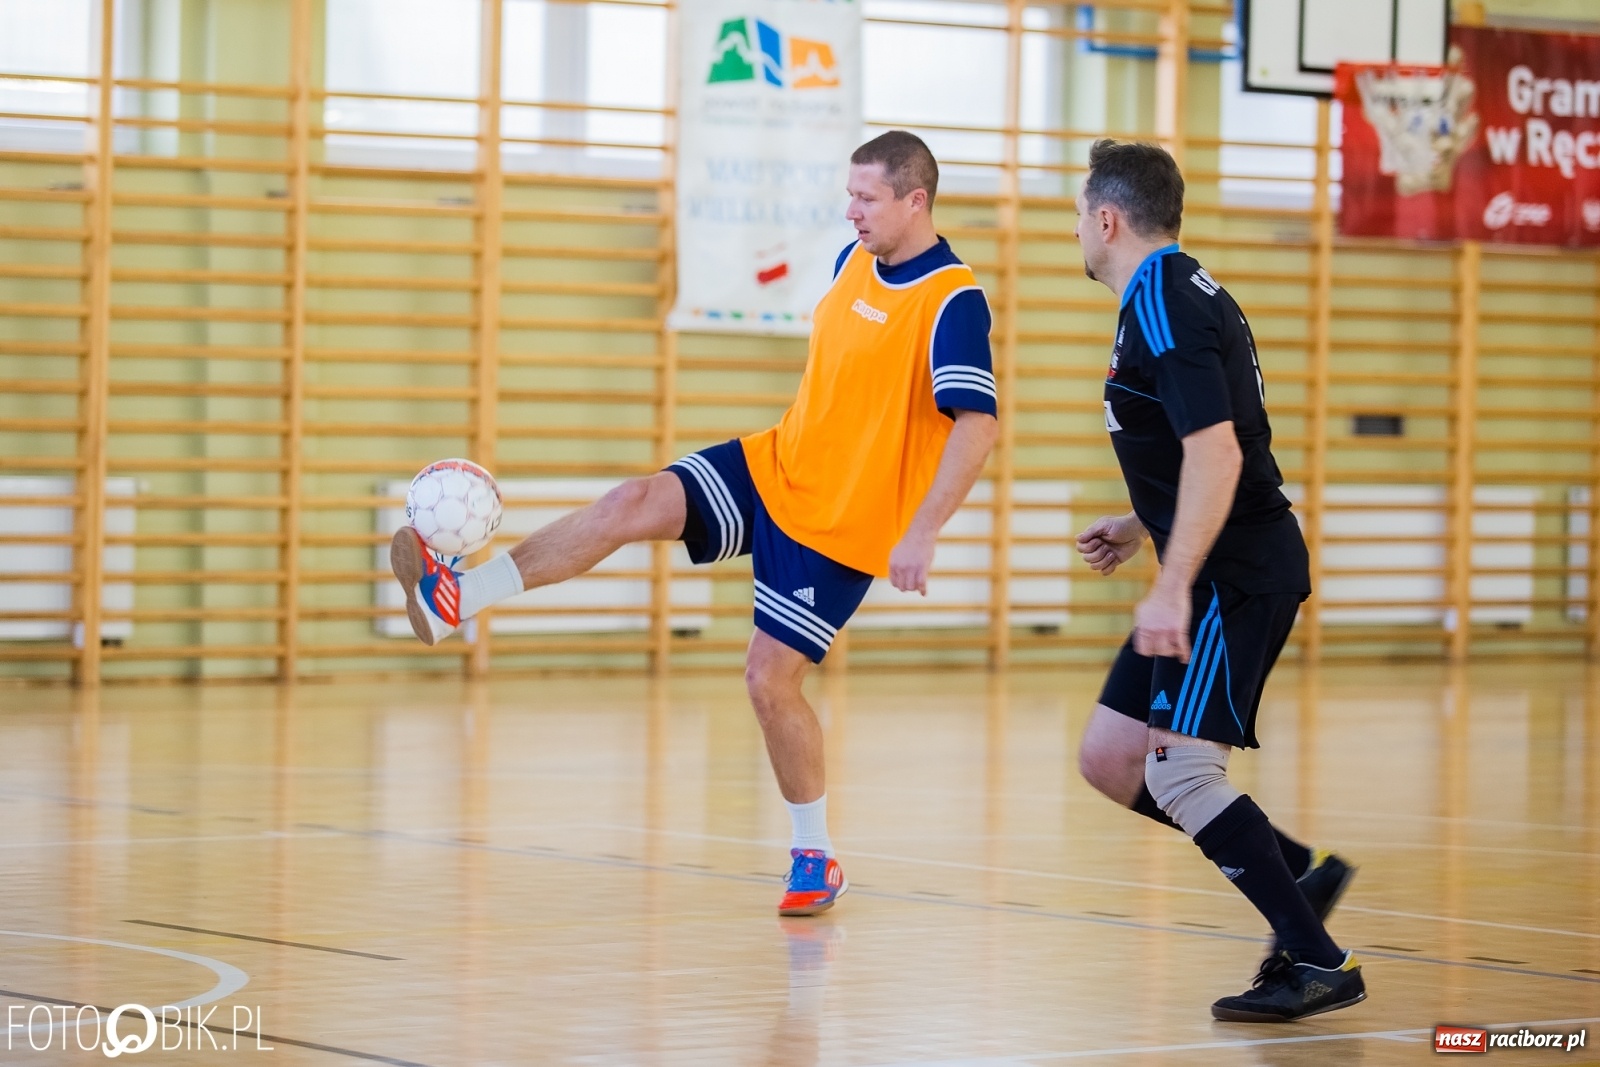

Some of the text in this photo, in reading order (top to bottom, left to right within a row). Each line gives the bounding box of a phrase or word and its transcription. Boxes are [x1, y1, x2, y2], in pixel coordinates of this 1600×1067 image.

[1485, 118, 1600, 179] w Ręc
[852, 298, 888, 324] Kappa
